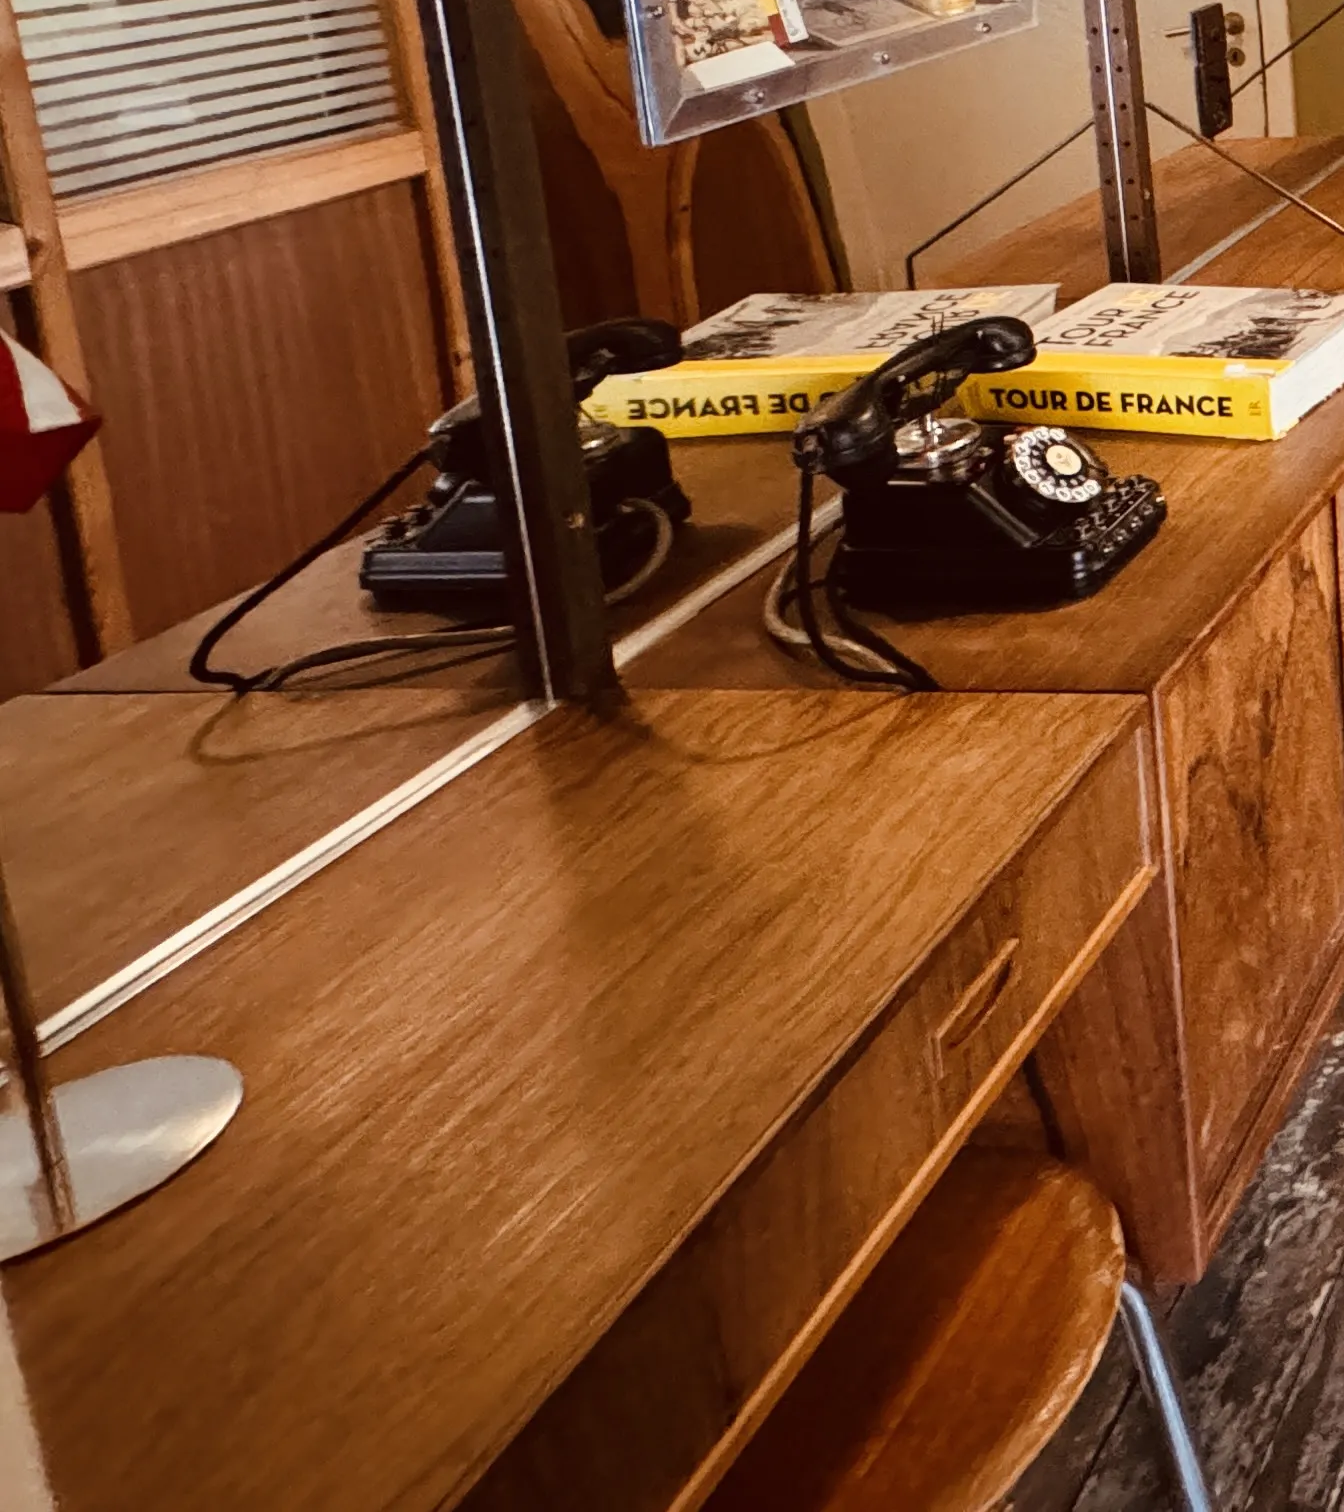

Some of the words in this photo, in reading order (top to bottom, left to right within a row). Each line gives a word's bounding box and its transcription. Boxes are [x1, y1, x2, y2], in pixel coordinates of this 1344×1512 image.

[1035, 307, 1135, 346] TOUR
[1080, 290, 1201, 348] FRANCE
[990, 388, 1067, 411] TOUR
[1076, 391, 1113, 413] DE
[1121, 393, 1233, 418] FRANCE
